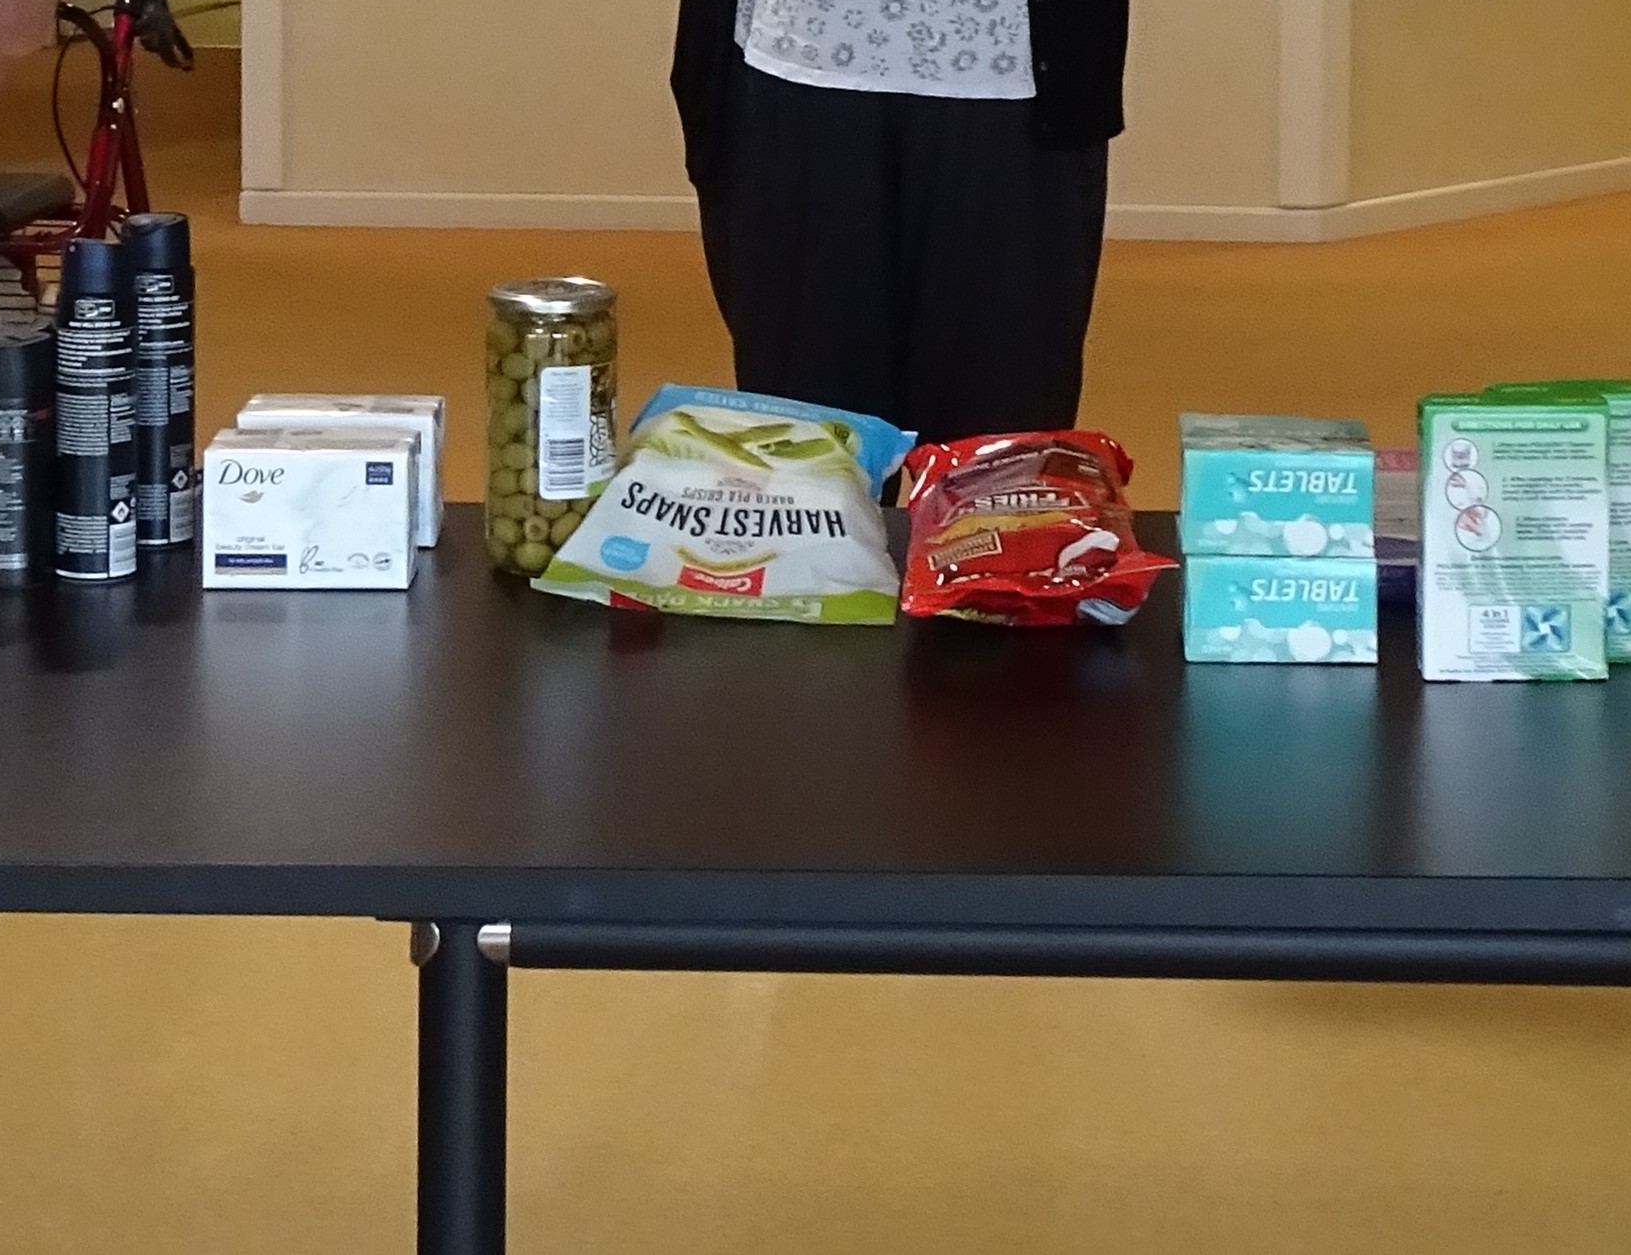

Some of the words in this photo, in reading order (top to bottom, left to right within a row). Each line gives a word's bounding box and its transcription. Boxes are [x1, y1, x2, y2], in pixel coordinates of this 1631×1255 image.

[218, 458, 285, 486] Dove
[1248, 470, 1358, 494] TABLETS
[620, 481, 711, 537] SNAPS
[714, 506, 847, 538] HARVEST
[1250, 578, 1360, 603] TABLETS
